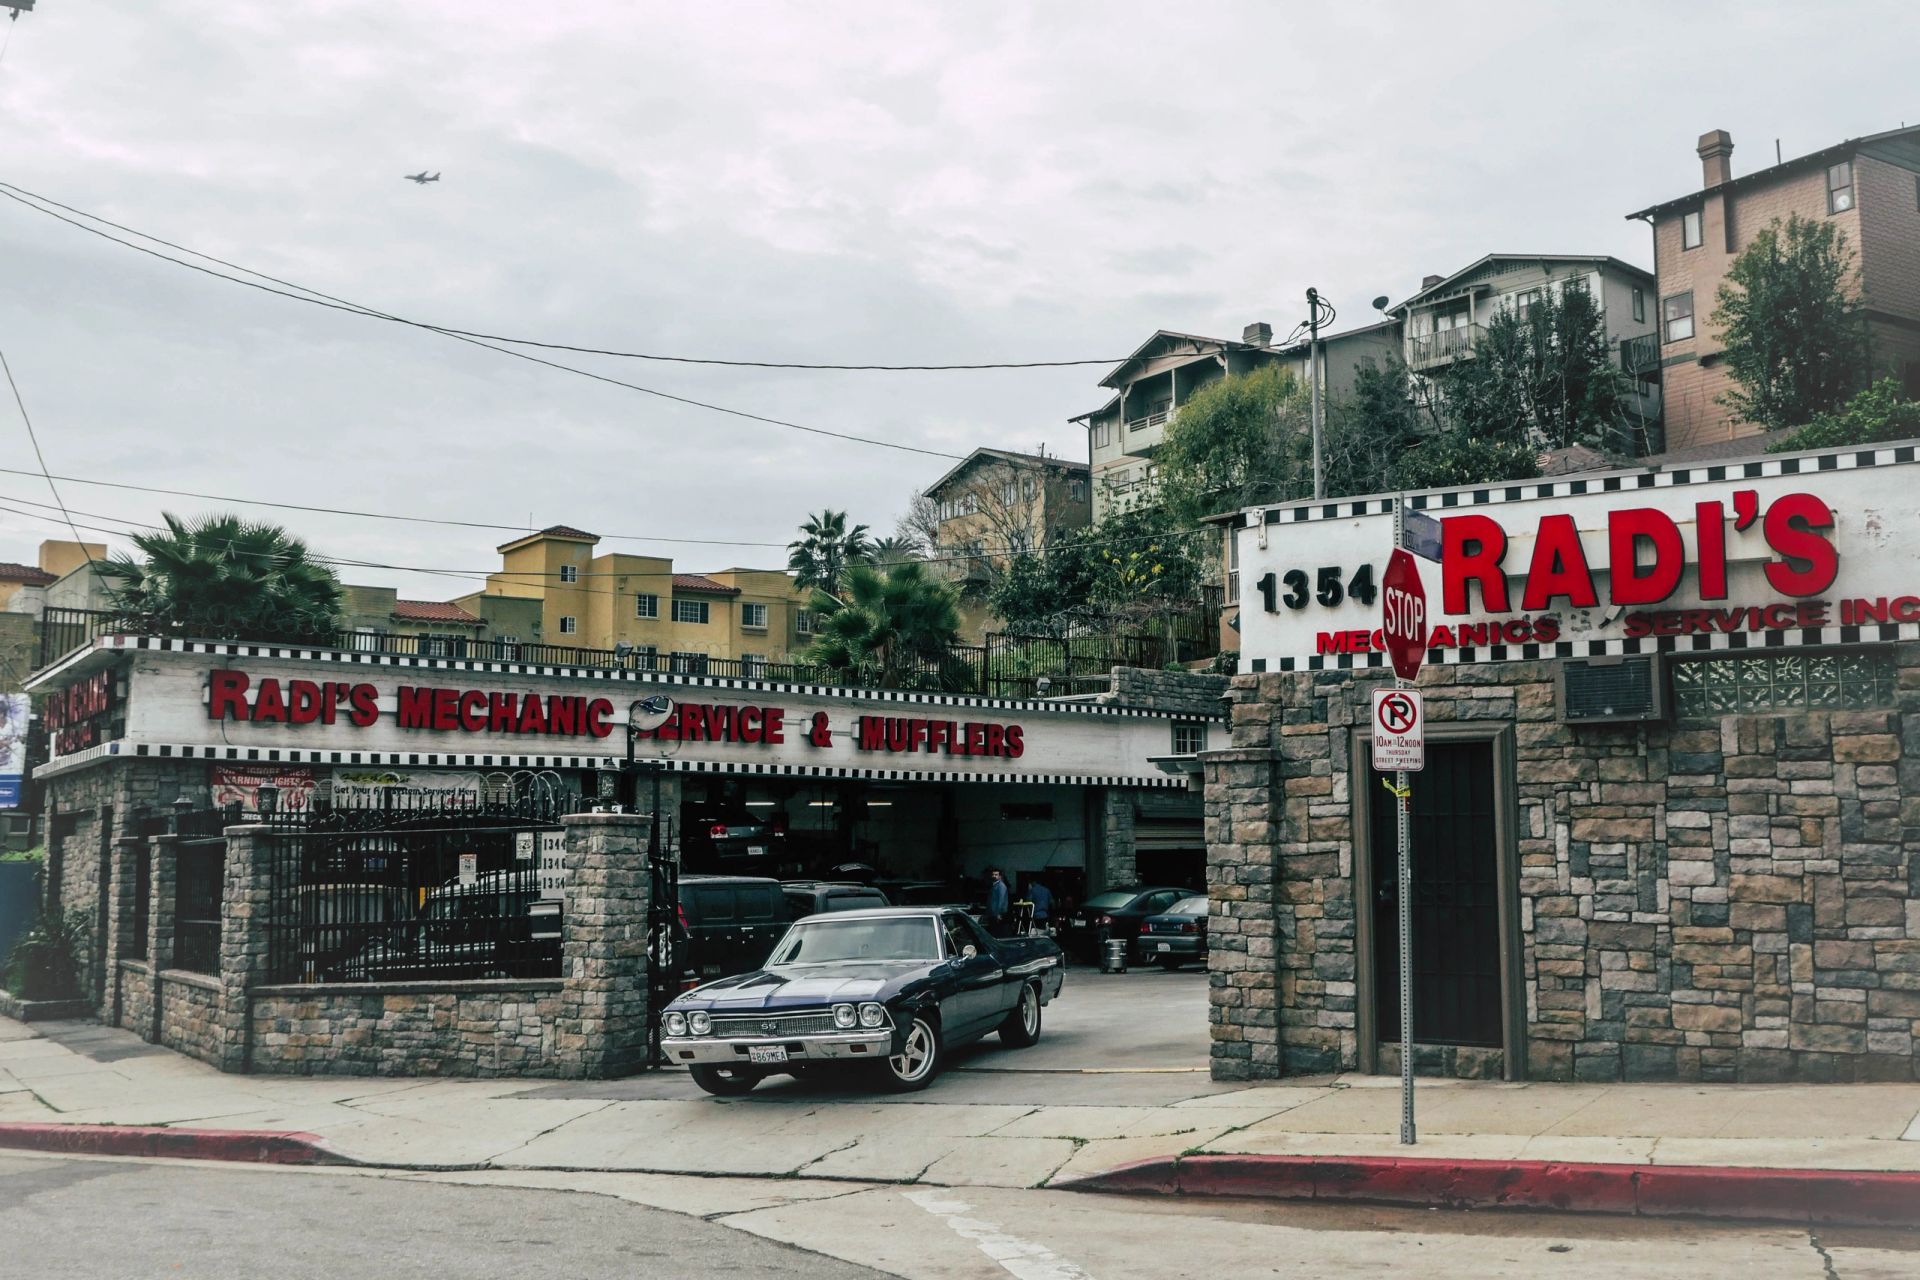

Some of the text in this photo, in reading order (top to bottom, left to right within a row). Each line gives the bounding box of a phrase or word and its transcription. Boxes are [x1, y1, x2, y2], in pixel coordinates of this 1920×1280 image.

[1440, 489, 1839, 615] RADI'S
[1257, 564, 1377, 614] 1354
[1386, 587, 1424, 641] STOP
[1317, 617, 1561, 654] MECANICS
[1623, 601, 1828, 638] SERVICE
[209, 669, 1024, 758] RADI'S MECHANIC ERVICE & MUFFLERS
